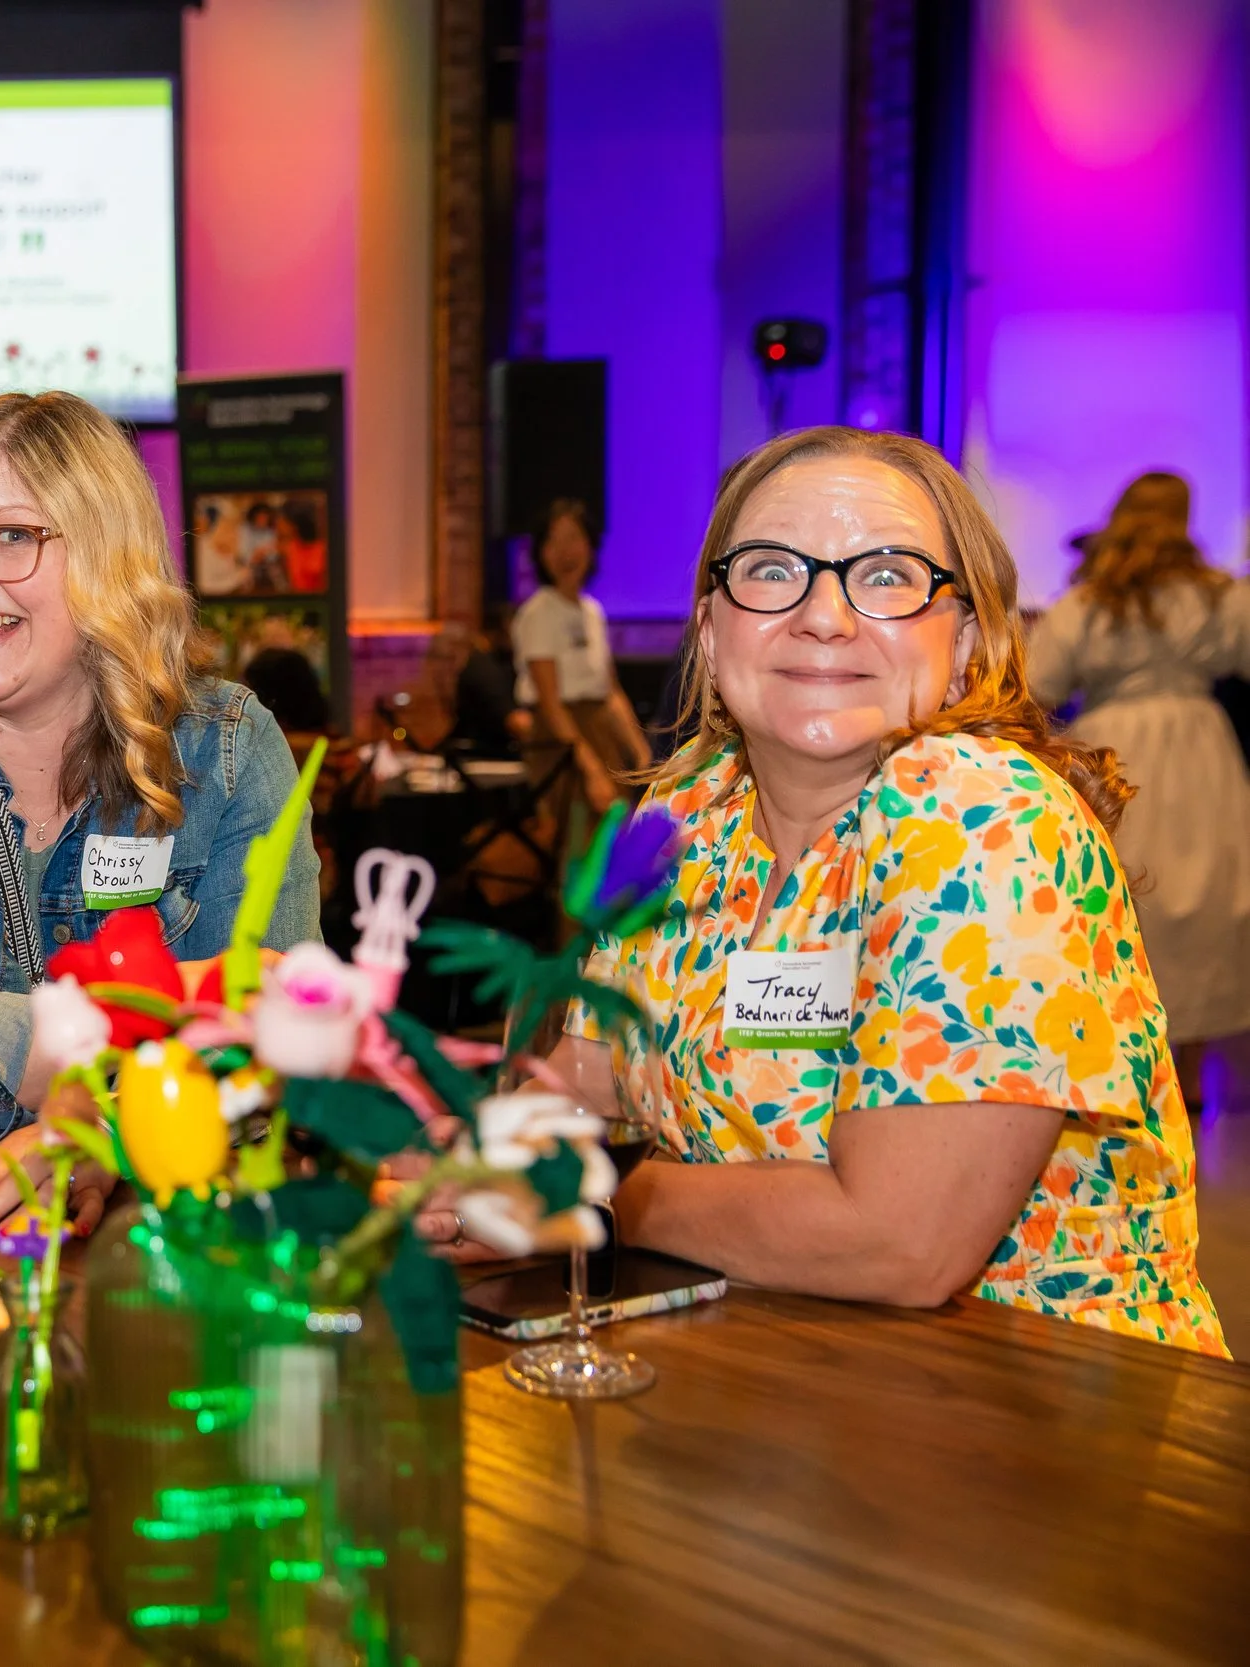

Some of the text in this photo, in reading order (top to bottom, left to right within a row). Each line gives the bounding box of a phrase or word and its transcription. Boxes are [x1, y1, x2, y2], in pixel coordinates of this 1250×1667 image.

[88, 848, 145, 874] Chrissy
[93, 869, 143, 886] Brown
[747, 975, 822, 1005] Tracy
[756, 1029, 788, 1039] Grantee,
[817, 1029, 841, 1037] Present
